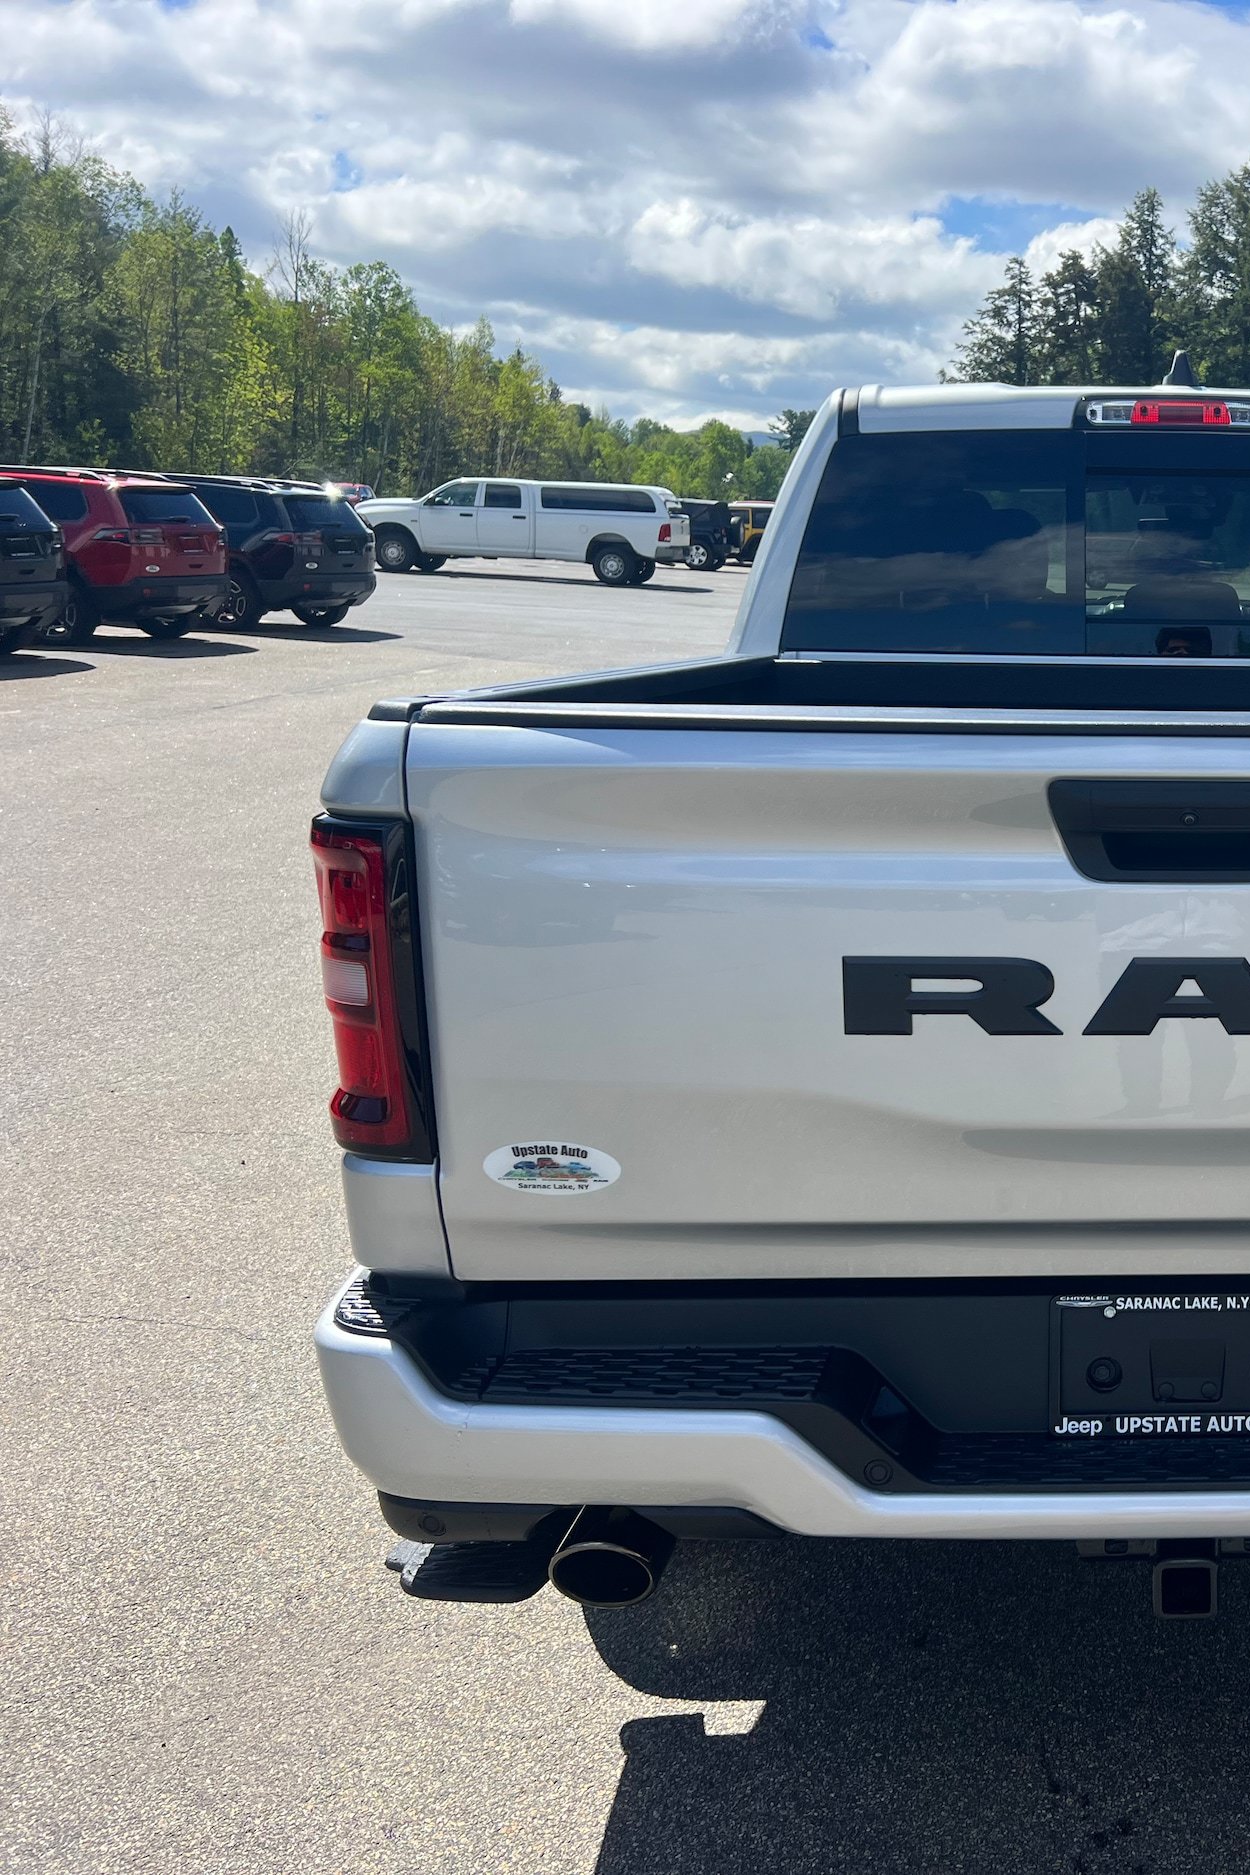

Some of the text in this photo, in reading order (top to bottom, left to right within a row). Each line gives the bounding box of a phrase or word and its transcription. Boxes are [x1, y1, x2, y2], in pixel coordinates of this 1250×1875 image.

[511, 1144, 588, 1159] Upstate Auto
[518, 1182, 551, 1190] Saranac
[553, 1183, 576, 1191] Lake,
[1116, 1297, 1181, 1310] SARANAC
[1184, 1296, 1222, 1311] LAKE,
[1054, 1416, 1103, 1436] Jeep
[1115, 1416, 1201, 1434] UPSTATE
